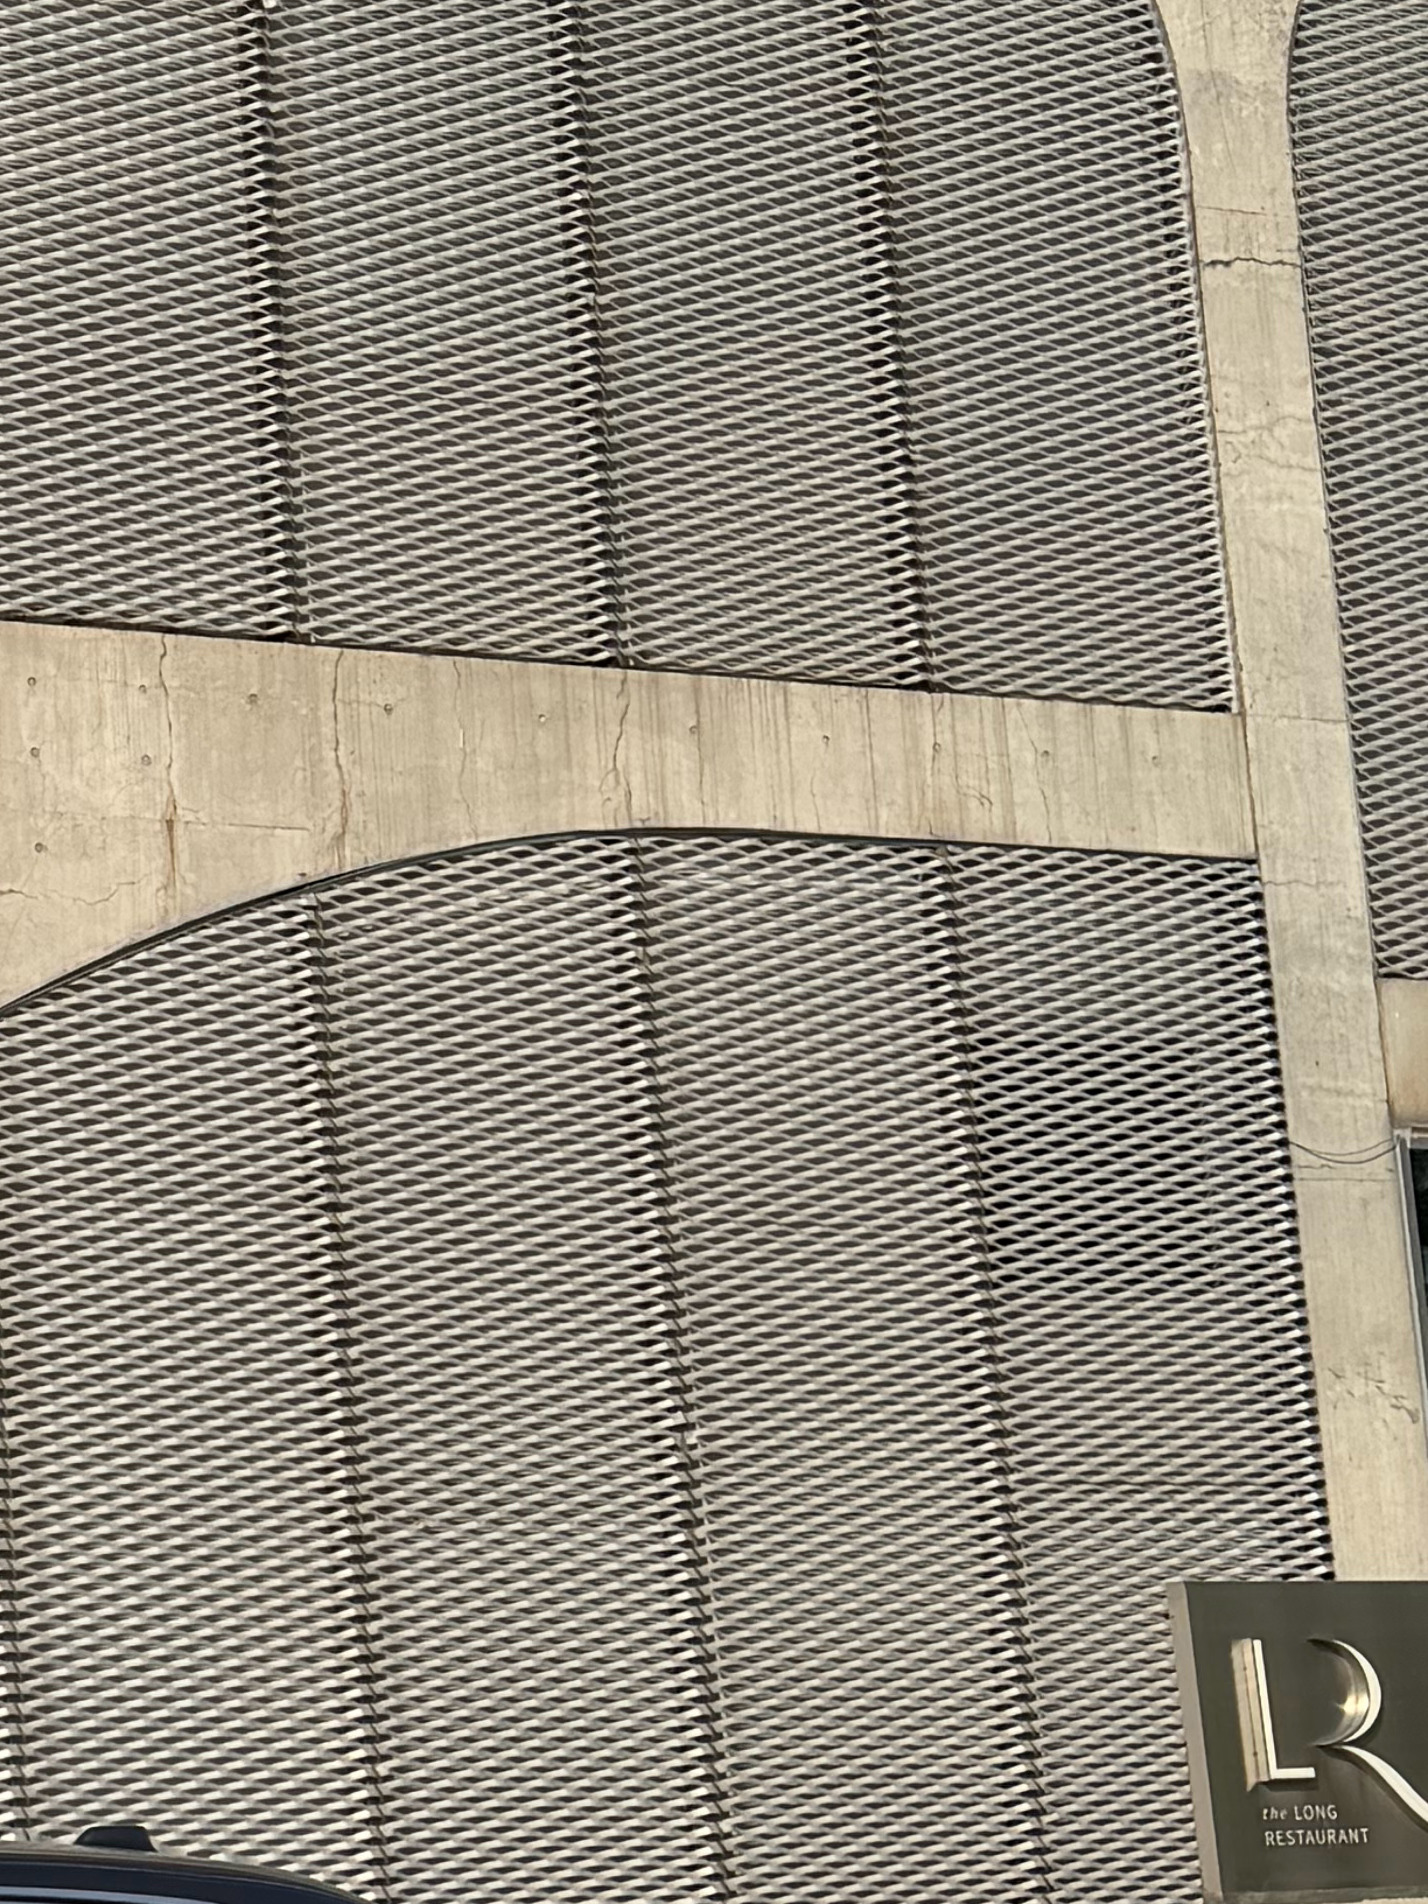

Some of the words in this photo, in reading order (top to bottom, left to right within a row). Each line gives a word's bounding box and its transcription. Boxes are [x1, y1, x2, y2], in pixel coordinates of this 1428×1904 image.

[1262, 1807, 1288, 1821] the
[1294, 1804, 1338, 1821] LONG
[1265, 1827, 1369, 1846] RESTAURANT
